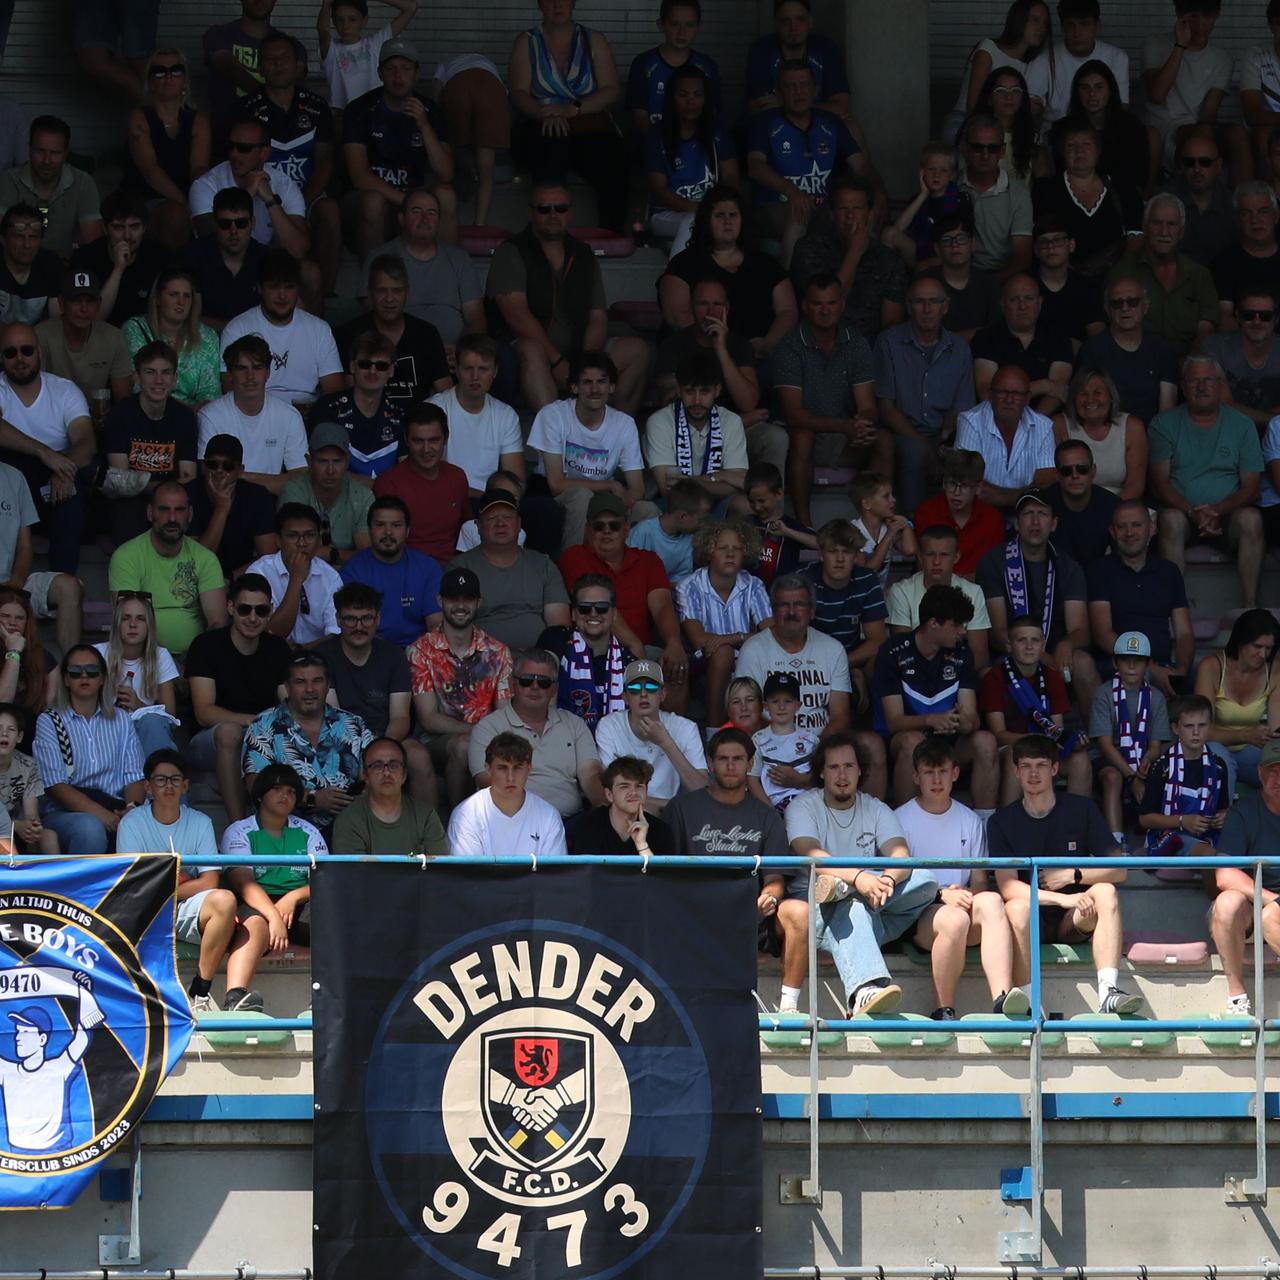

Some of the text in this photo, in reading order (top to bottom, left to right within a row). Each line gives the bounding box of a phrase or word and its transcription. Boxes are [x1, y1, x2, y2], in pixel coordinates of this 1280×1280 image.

[568, 460, 608, 476] Columbia
[12, 896, 54, 910] ALTIJD
[56, 901, 93, 928] THUIS
[23, 923, 100, 970] BOYS
[0, 973, 42, 994] 9470
[412, 940, 657, 1043] DENDER
[62, 1145, 100, 1168] SINDS
[99, 1119, 132, 1151] 2023
[502, 1170, 580, 1196] F.C.D.
[422, 1180, 650, 1268] 9473
